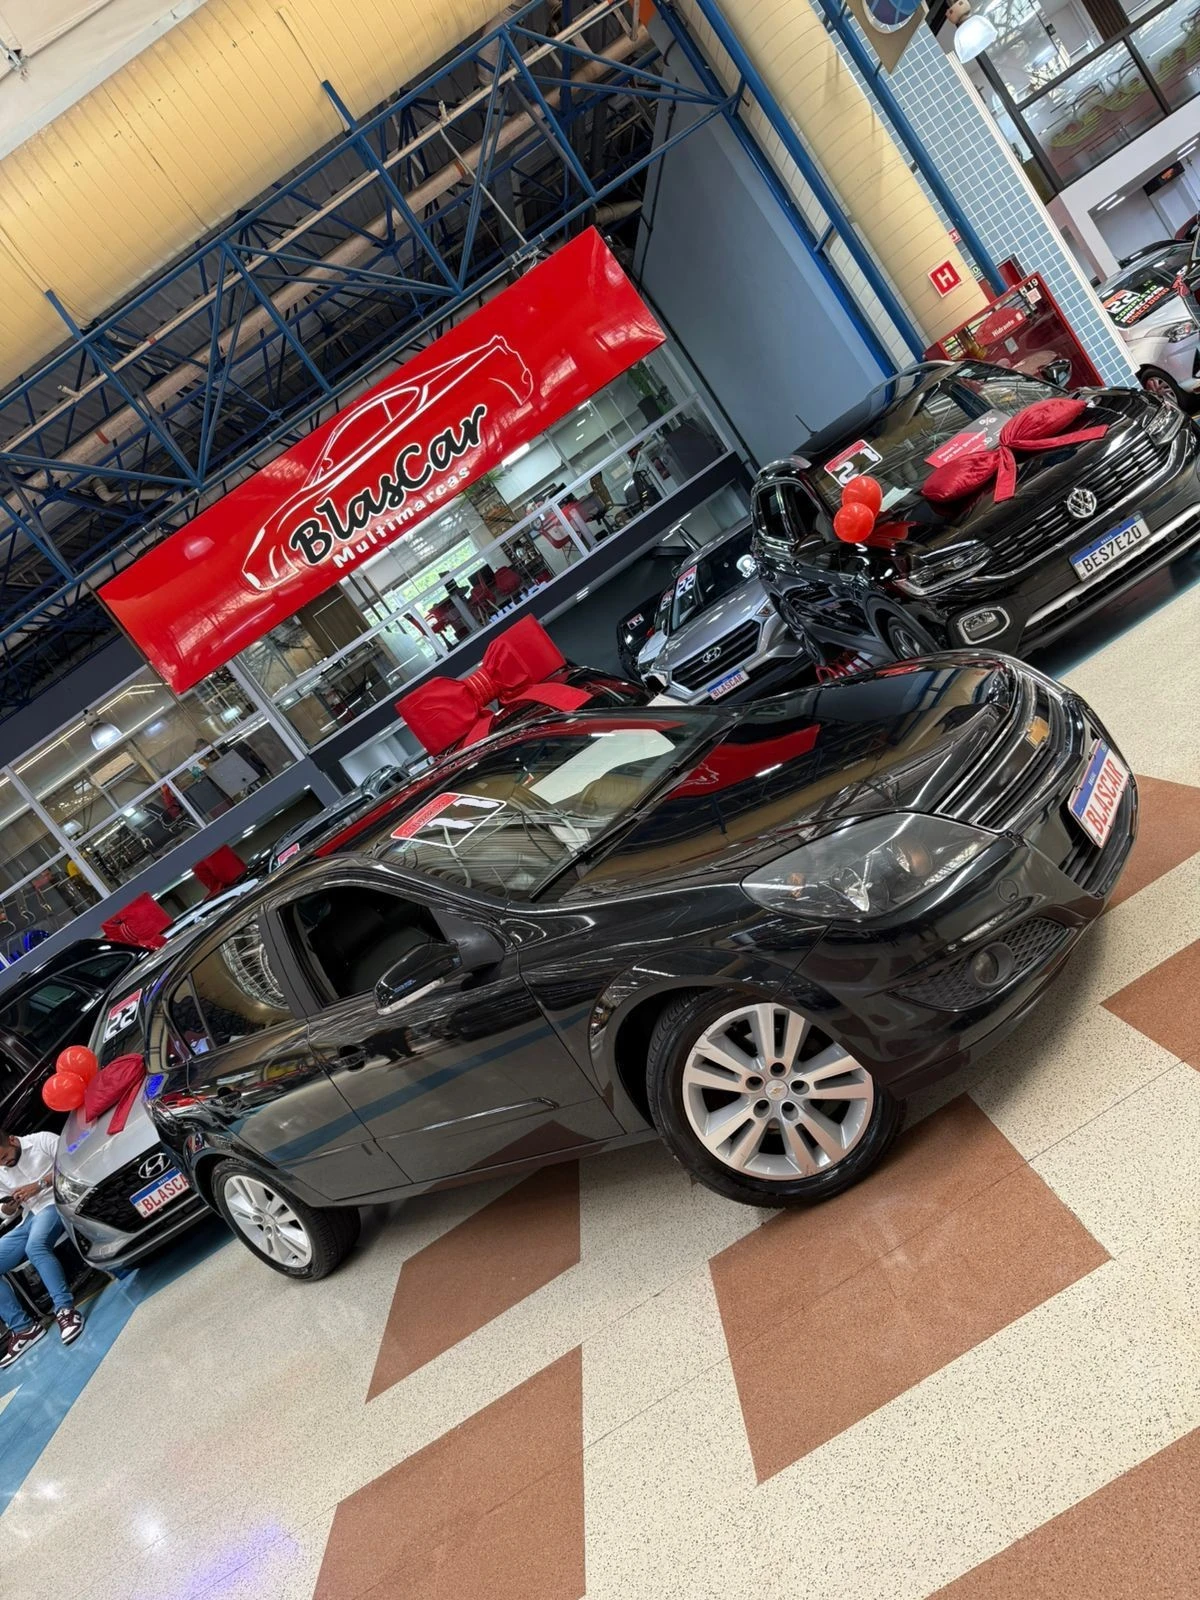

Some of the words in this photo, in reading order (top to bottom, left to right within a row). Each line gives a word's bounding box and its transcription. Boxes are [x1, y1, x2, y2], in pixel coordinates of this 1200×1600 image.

[936, 267, 955, 288] H
[1027, 278, 1039, 289] 19
[1106, 292, 1139, 314] 22
[1115, 285, 1157, 321] COMPLETO
[991, 319, 1015, 337] Hidrante
[835, 448, 879, 484] 21
[289, 404, 487, 566] BlasCar
[331, 466, 471, 568] Multimarcas
[1081, 525, 1142, 573] BES7E20
[677, 576, 695, 595] 22
[712, 674, 744, 697] BLASCAR
[1086, 758, 1124, 835] BLASCAR
[427, 798, 500, 829] 11
[105, 1001, 137, 1039] 22
